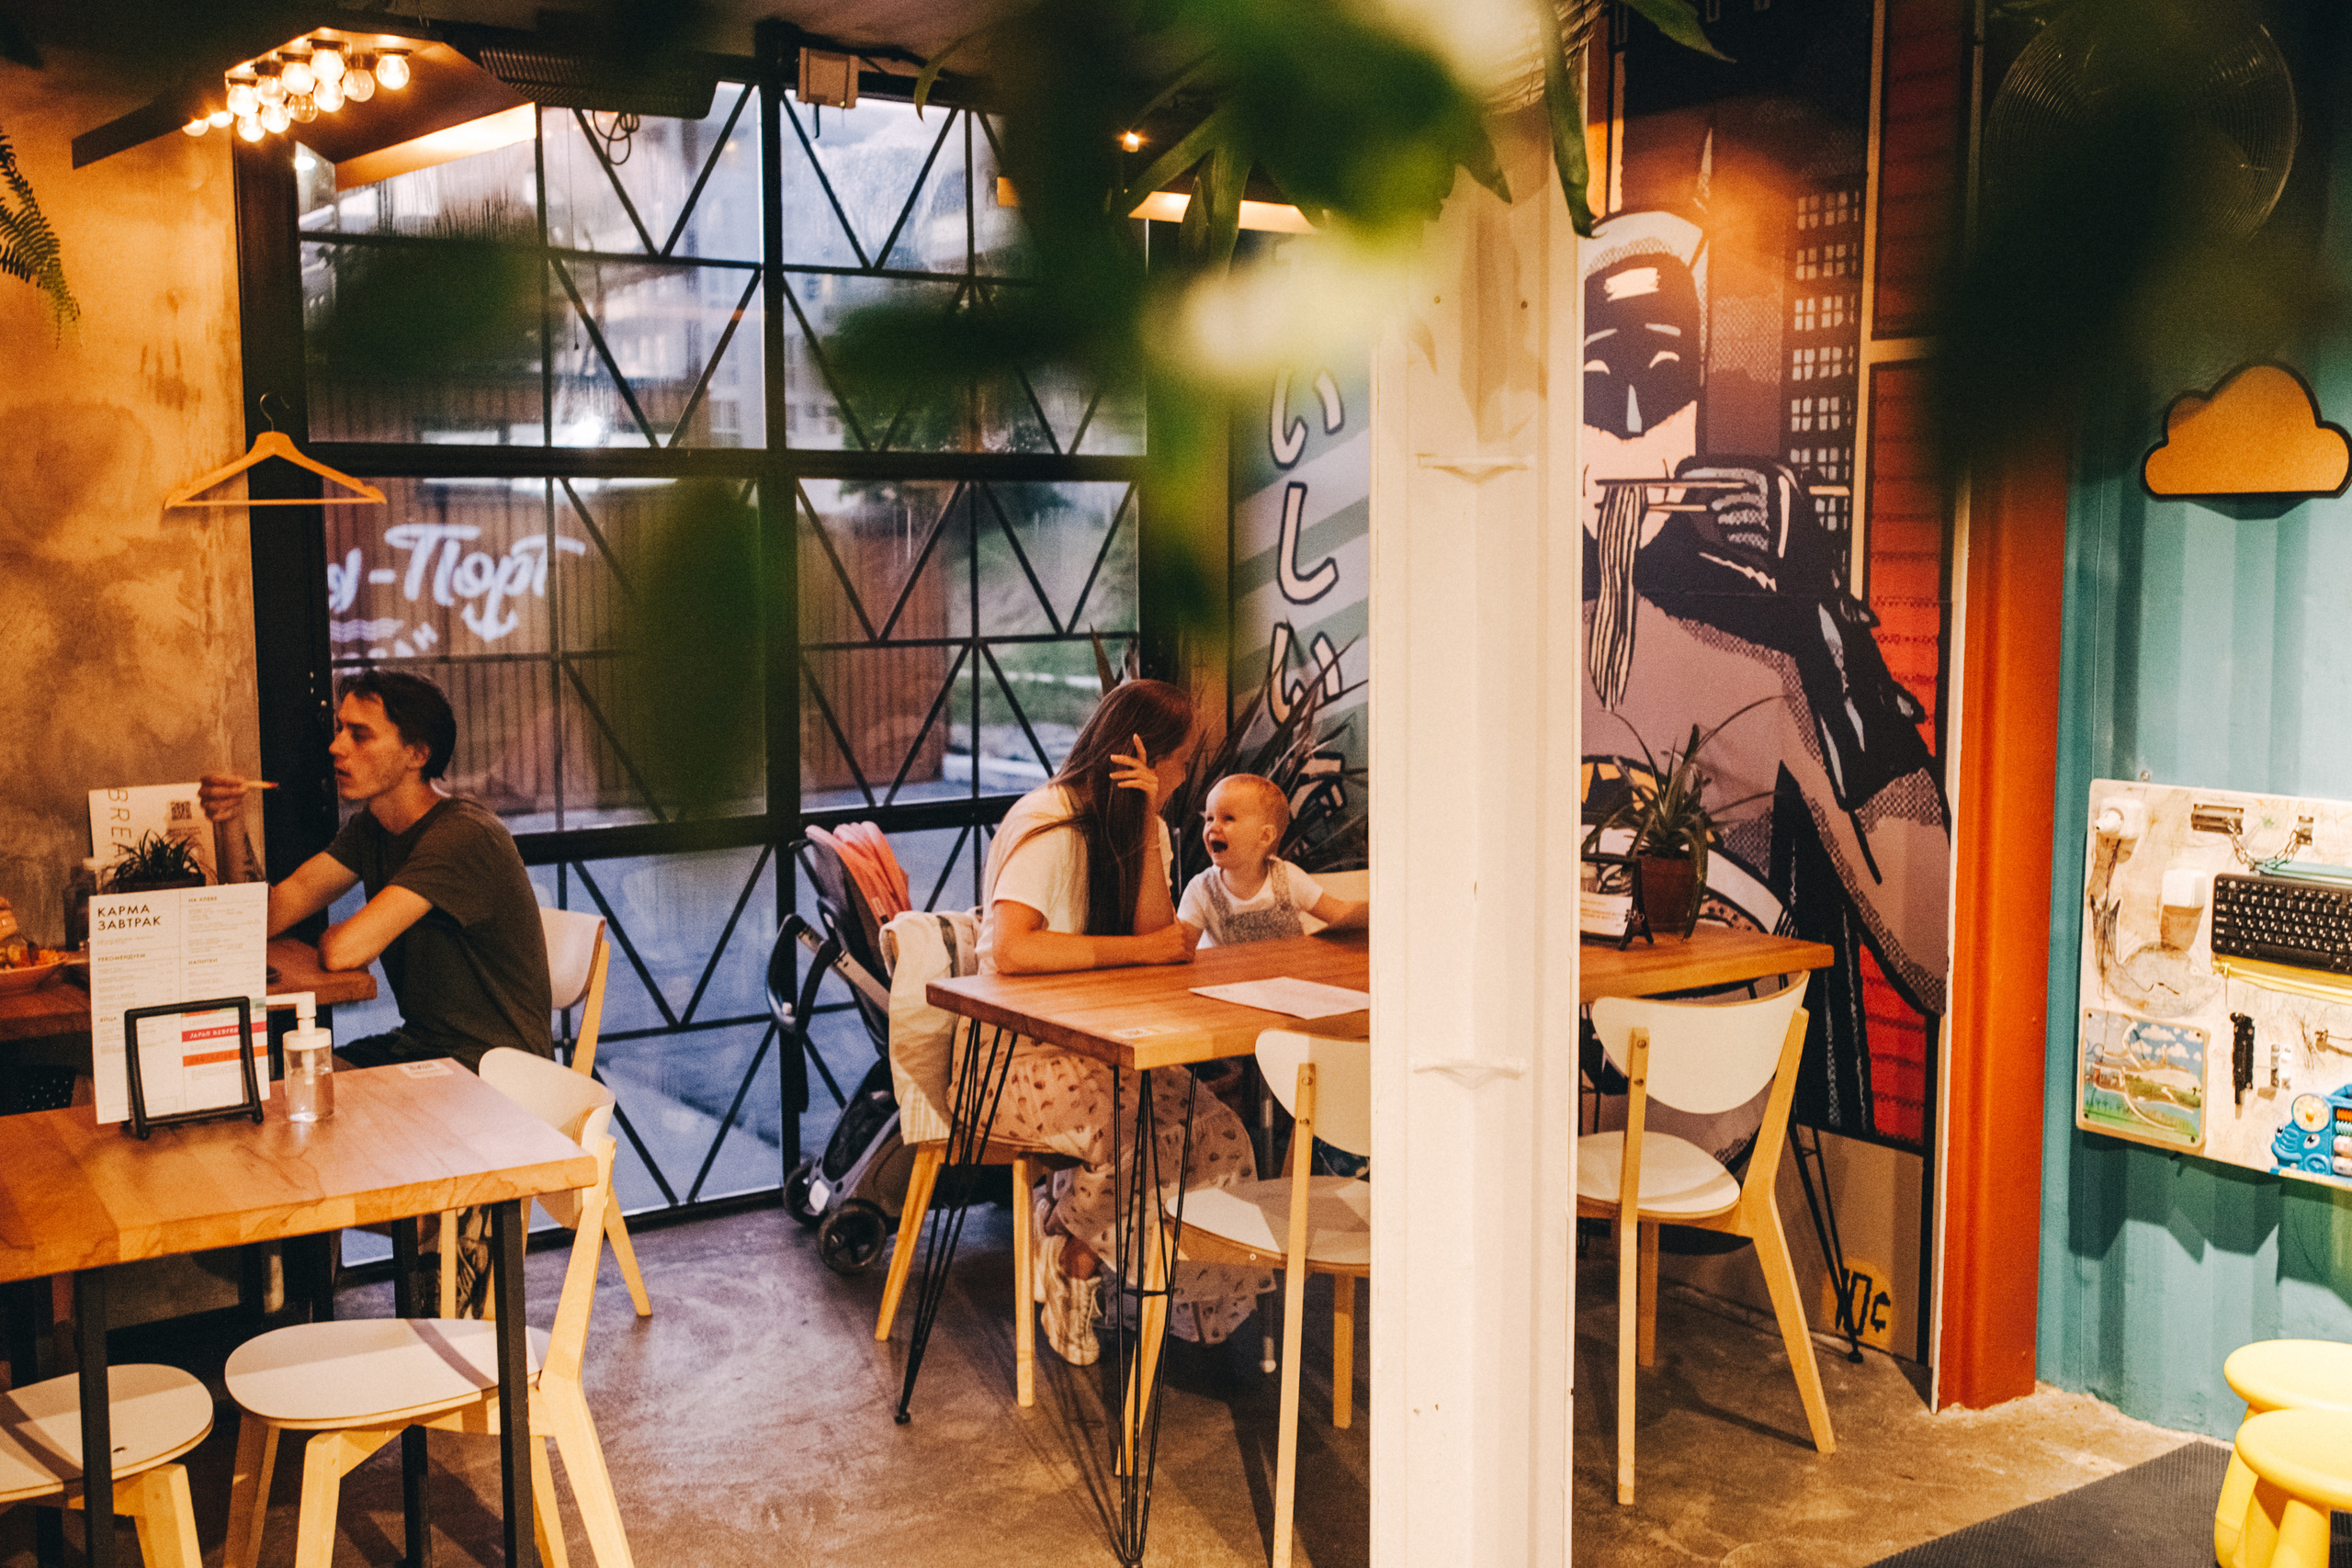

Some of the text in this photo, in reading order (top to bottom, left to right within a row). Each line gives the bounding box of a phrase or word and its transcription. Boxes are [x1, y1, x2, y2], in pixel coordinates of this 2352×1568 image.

[97, 904, 150, 918] КАРМА
[97, 915, 162, 931] ЗАВТРАК
[97, 953, 146, 962] РЕКОМЕНДУЕМ
[189, 1031, 210, 1039] JAPAN
